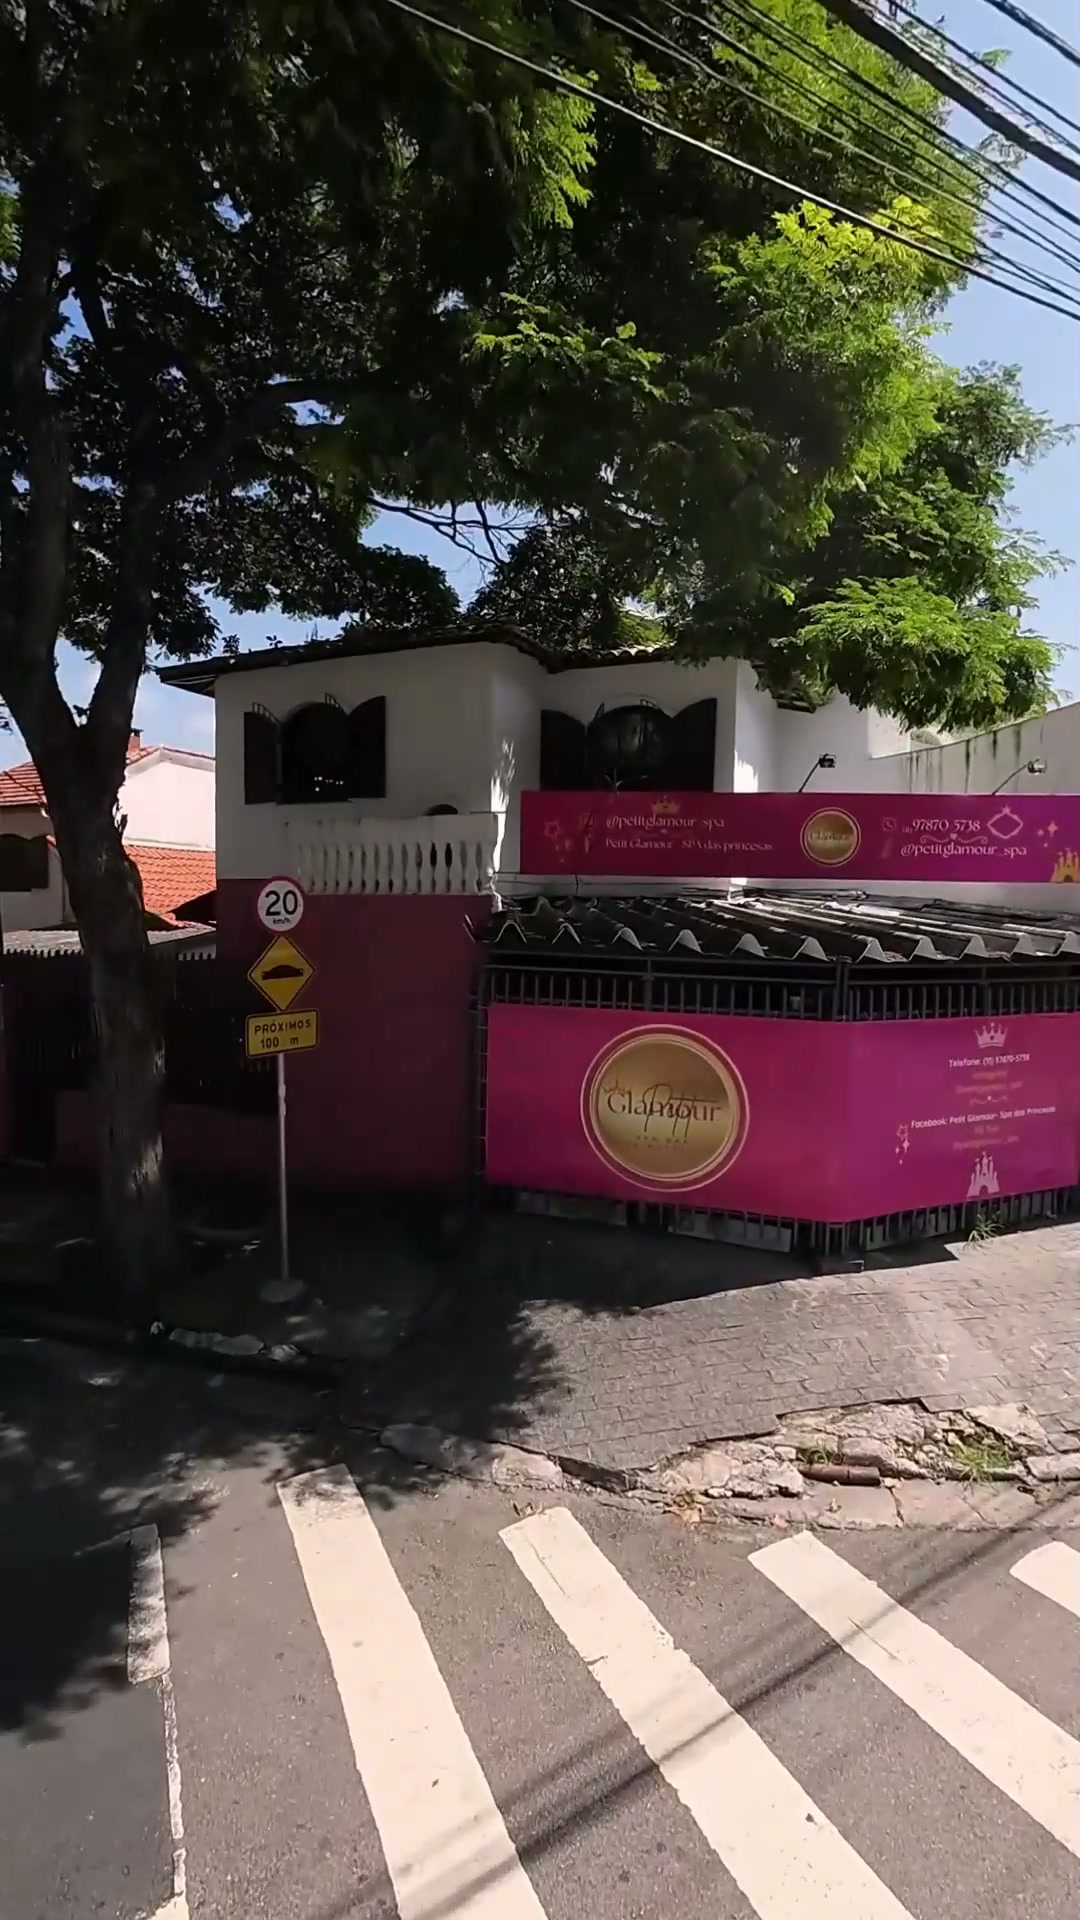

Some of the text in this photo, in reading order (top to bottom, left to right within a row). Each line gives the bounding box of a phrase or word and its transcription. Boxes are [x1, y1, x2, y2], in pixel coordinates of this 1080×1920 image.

[912, 819, 949, 832] 97870
[953, 819, 981, 832] 5738
[265, 889, 298, 917] 20
[272, 917, 292, 925] km/h
[254, 1019, 312, 1035] PRÓXIMOS
[260, 1036, 299, 1050] 100 m
[607, 1090, 722, 1122] Glamour
[911, 1116, 948, 1129] Facebook:
